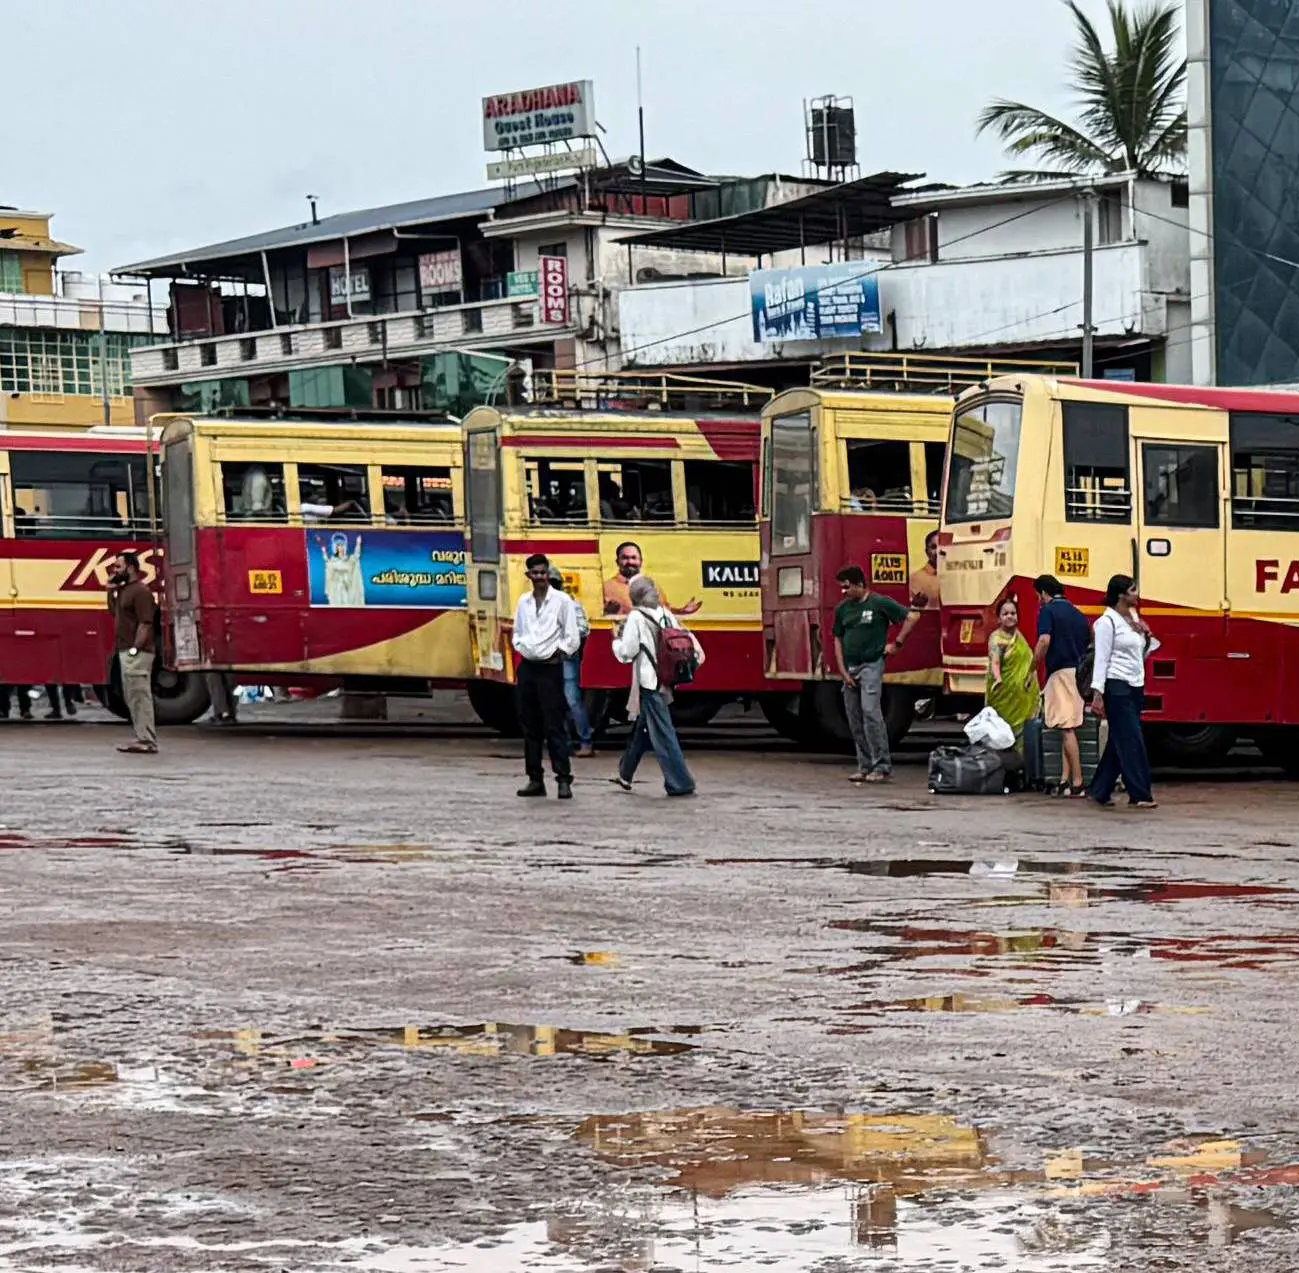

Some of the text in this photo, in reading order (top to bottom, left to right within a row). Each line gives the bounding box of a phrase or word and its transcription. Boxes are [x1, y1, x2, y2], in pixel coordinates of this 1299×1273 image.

[485, 84, 582, 118] ARADHANA
[495, 111, 574, 135] Guest House
[331, 275, 369, 295] HOTEL
[420, 261, 461, 286] ROOMS
[547, 259, 565, 321] ROOMS
[708, 566, 759, 582] KALLI
